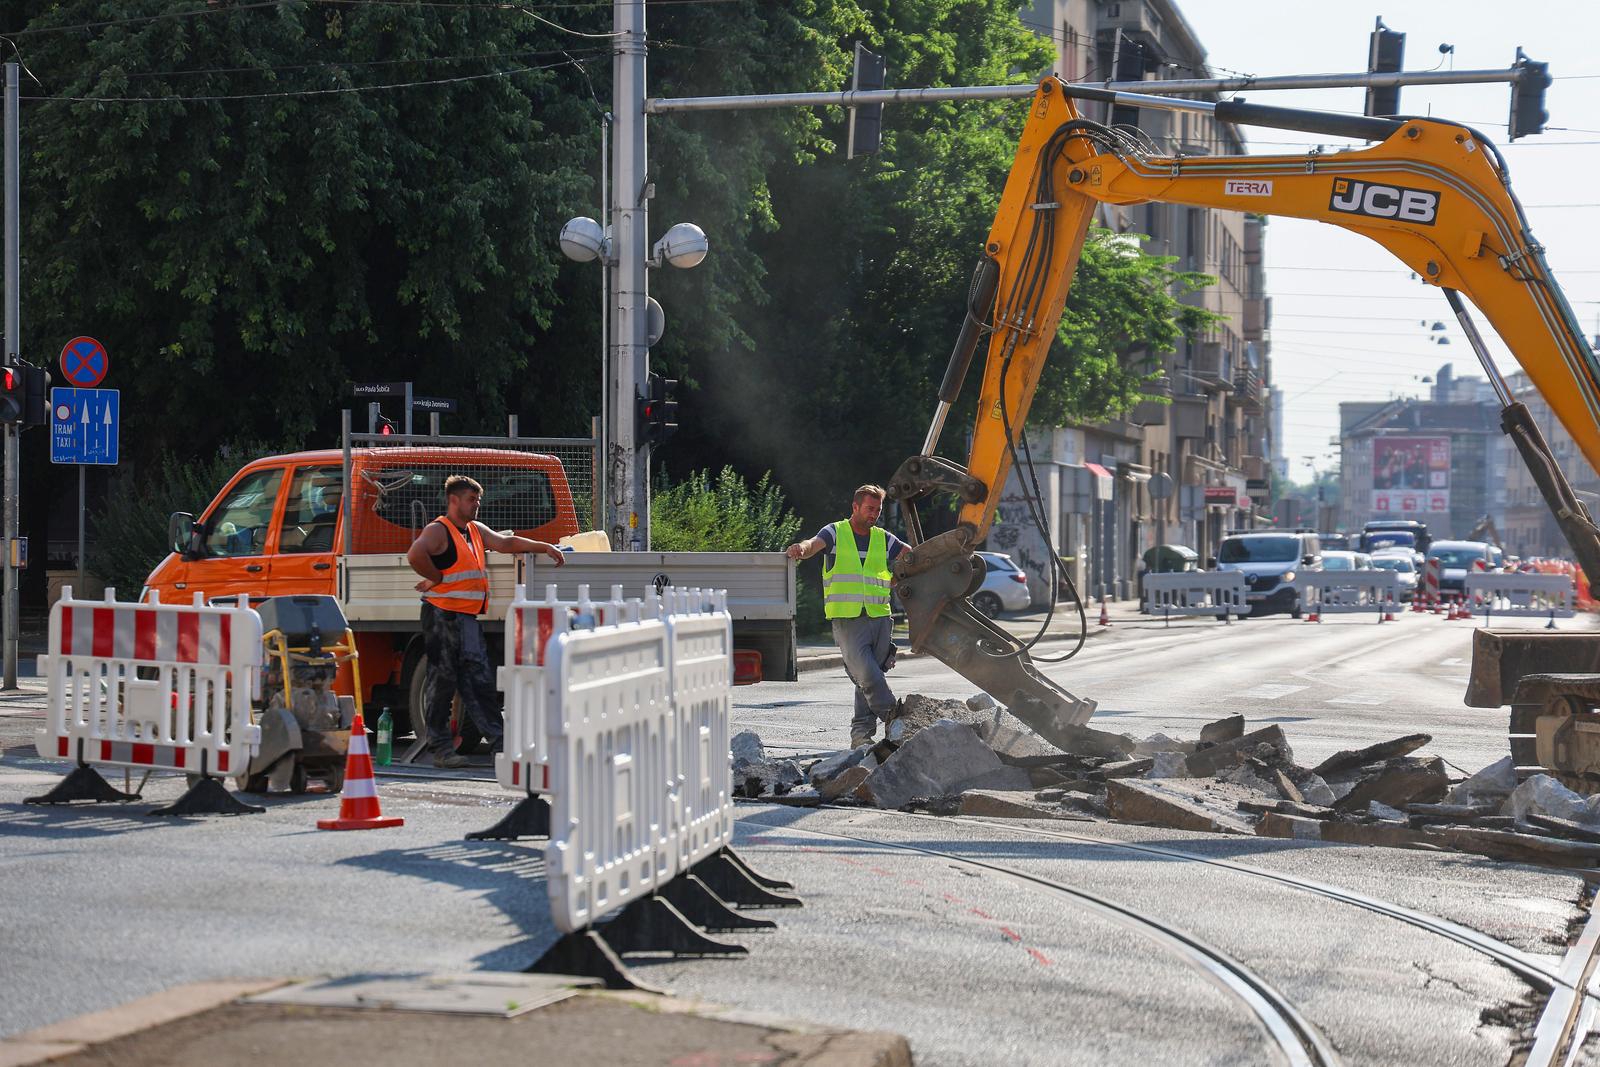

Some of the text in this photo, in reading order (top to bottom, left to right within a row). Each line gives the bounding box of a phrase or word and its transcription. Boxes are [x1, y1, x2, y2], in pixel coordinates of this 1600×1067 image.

[1228, 181, 1269, 194] TERRA
[1333, 182, 1437, 222] JCB
[54, 424, 72, 434] TRAM
[56, 437, 71, 447] TAXI
